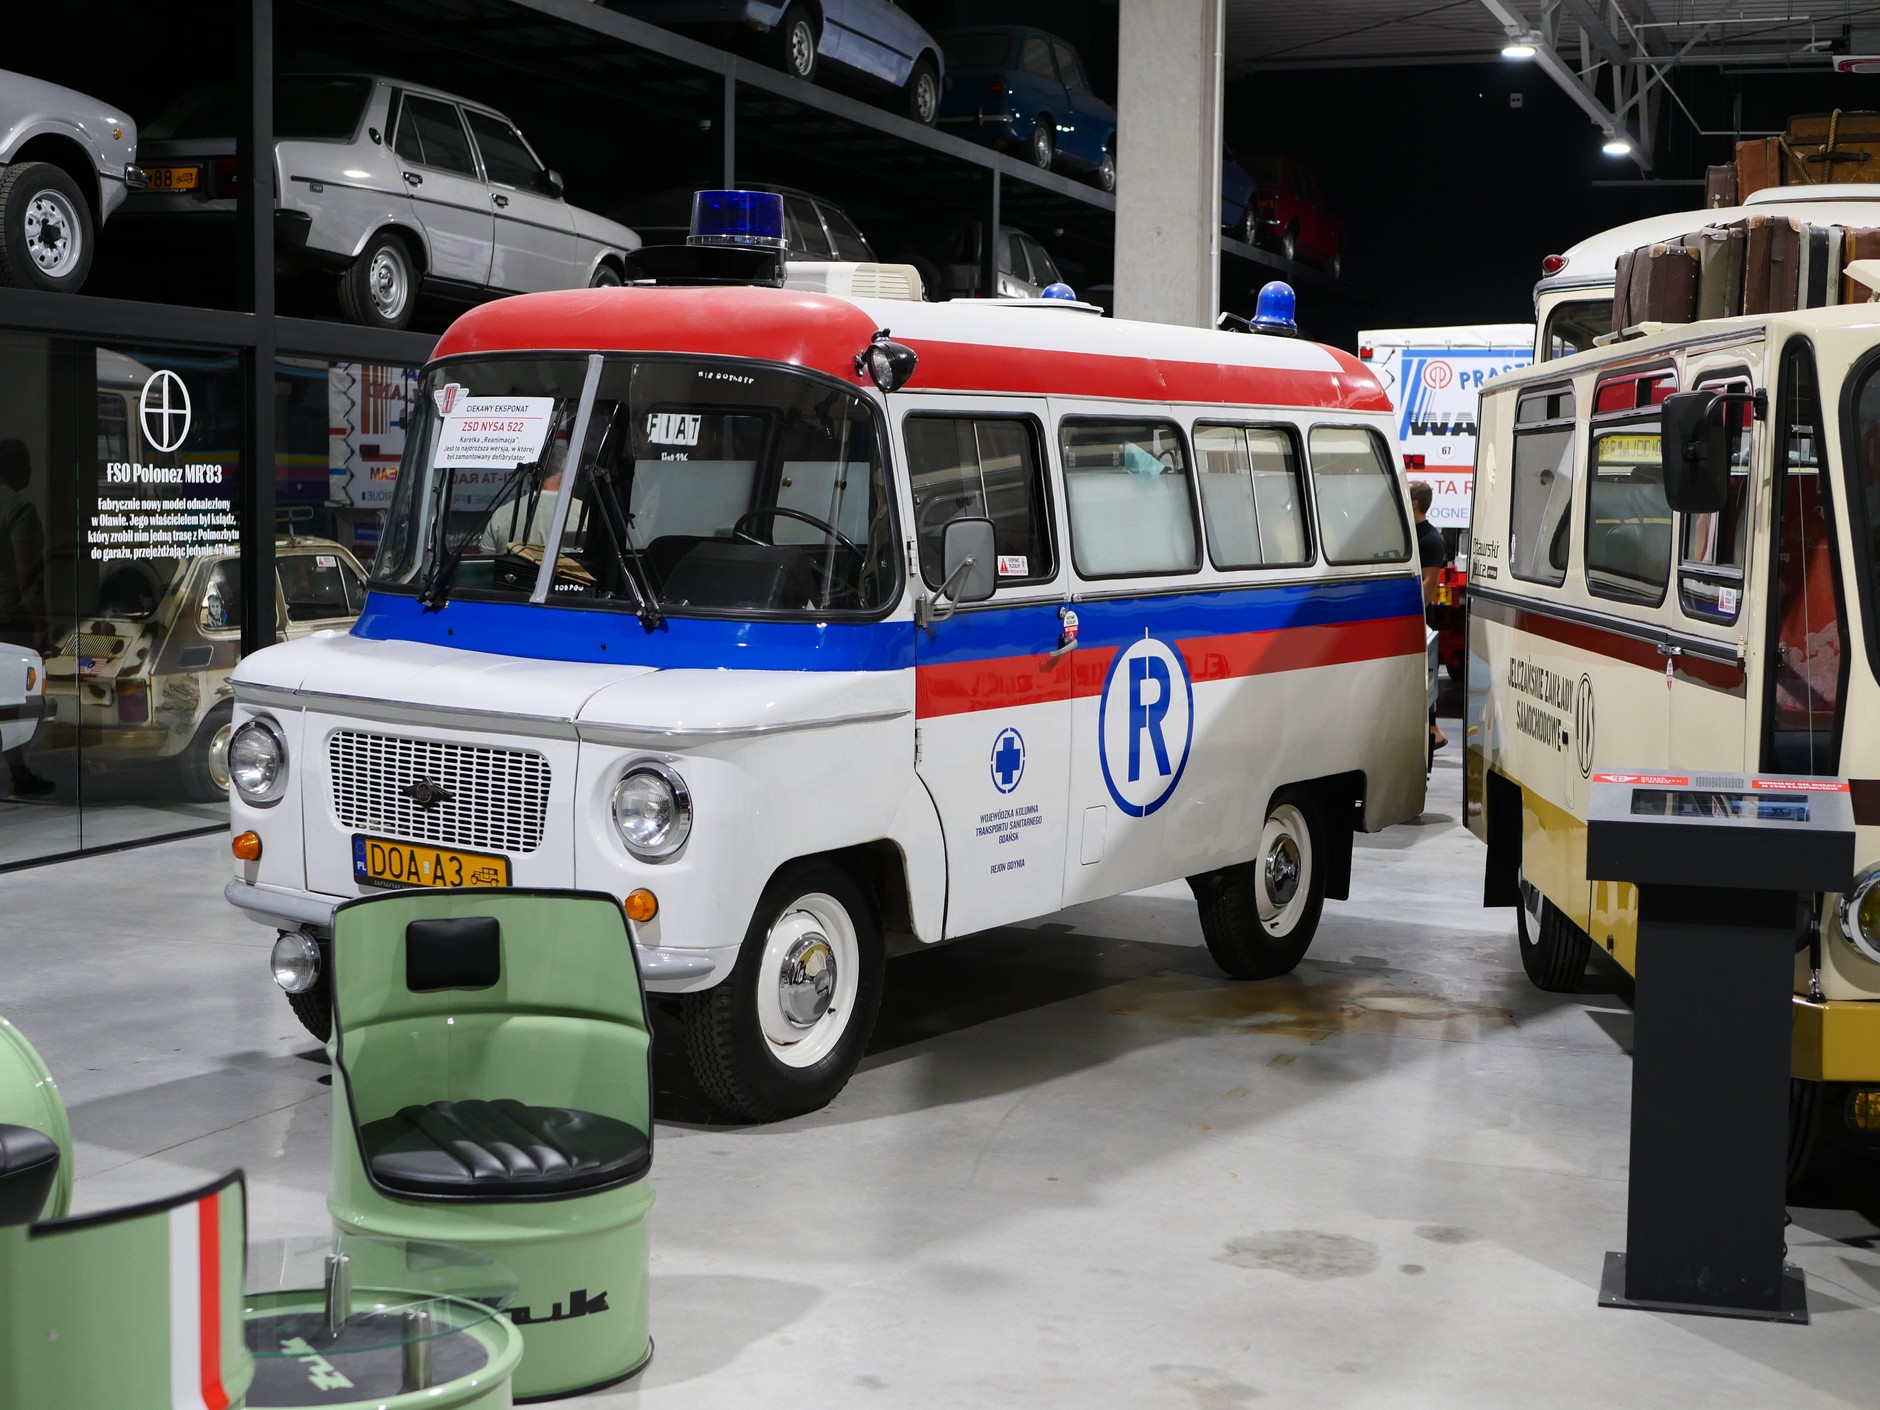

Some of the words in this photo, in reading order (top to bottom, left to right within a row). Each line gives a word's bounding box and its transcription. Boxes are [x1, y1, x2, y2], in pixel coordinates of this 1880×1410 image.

[494, 405, 529, 413] EKSPONAT
[461, 421, 479, 432] ZSD
[480, 422, 504, 432] NYSA
[507, 422, 524, 432] 522
[648, 414, 700, 441] FIAT
[1442, 446, 1452, 455] 67
[107, 462, 131, 483] FSO
[133, 464, 183, 483] Polonez
[97, 498, 141, 512] Fabrycznie
[141, 501, 161, 512] nowy
[162, 498, 186, 510] model
[187, 498, 231, 512] odnaleziony
[91, 516, 98, 526] w
[129, 513, 149, 528] Jego
[150, 512, 198, 526] właścicielem
[200, 513, 211, 527] był
[87, 530, 110, 545] który
[110, 529, 133, 543] zrobił
[134, 529, 149, 542] nim
[150, 528, 172, 544] jedną
[172, 529, 192, 543] trasę
[193, 531, 197, 540] z
[198, 529, 239, 542] Polmozbytu
[91, 547, 102, 560] do
[103, 546, 133, 562] garażu,
[186, 544, 213, 557] jedynie
[1127, 655, 1172, 782] R
[980, 809, 1014, 824] WOJEWÓDZKA
[1015, 804, 1039, 817] KOLUMNA
[976, 822, 1009, 837] TRANSPORTU
[1009, 815, 1043, 830] SANITARNEGO
[998, 831, 1019, 844] GDAŃSK
[357, 861, 367, 871] PL
[371, 843, 421, 883] DOA
[432, 853, 464, 887] A3
[990, 863, 1006, 874] REJON
[1006, 858, 1025, 871] GDYNIA
